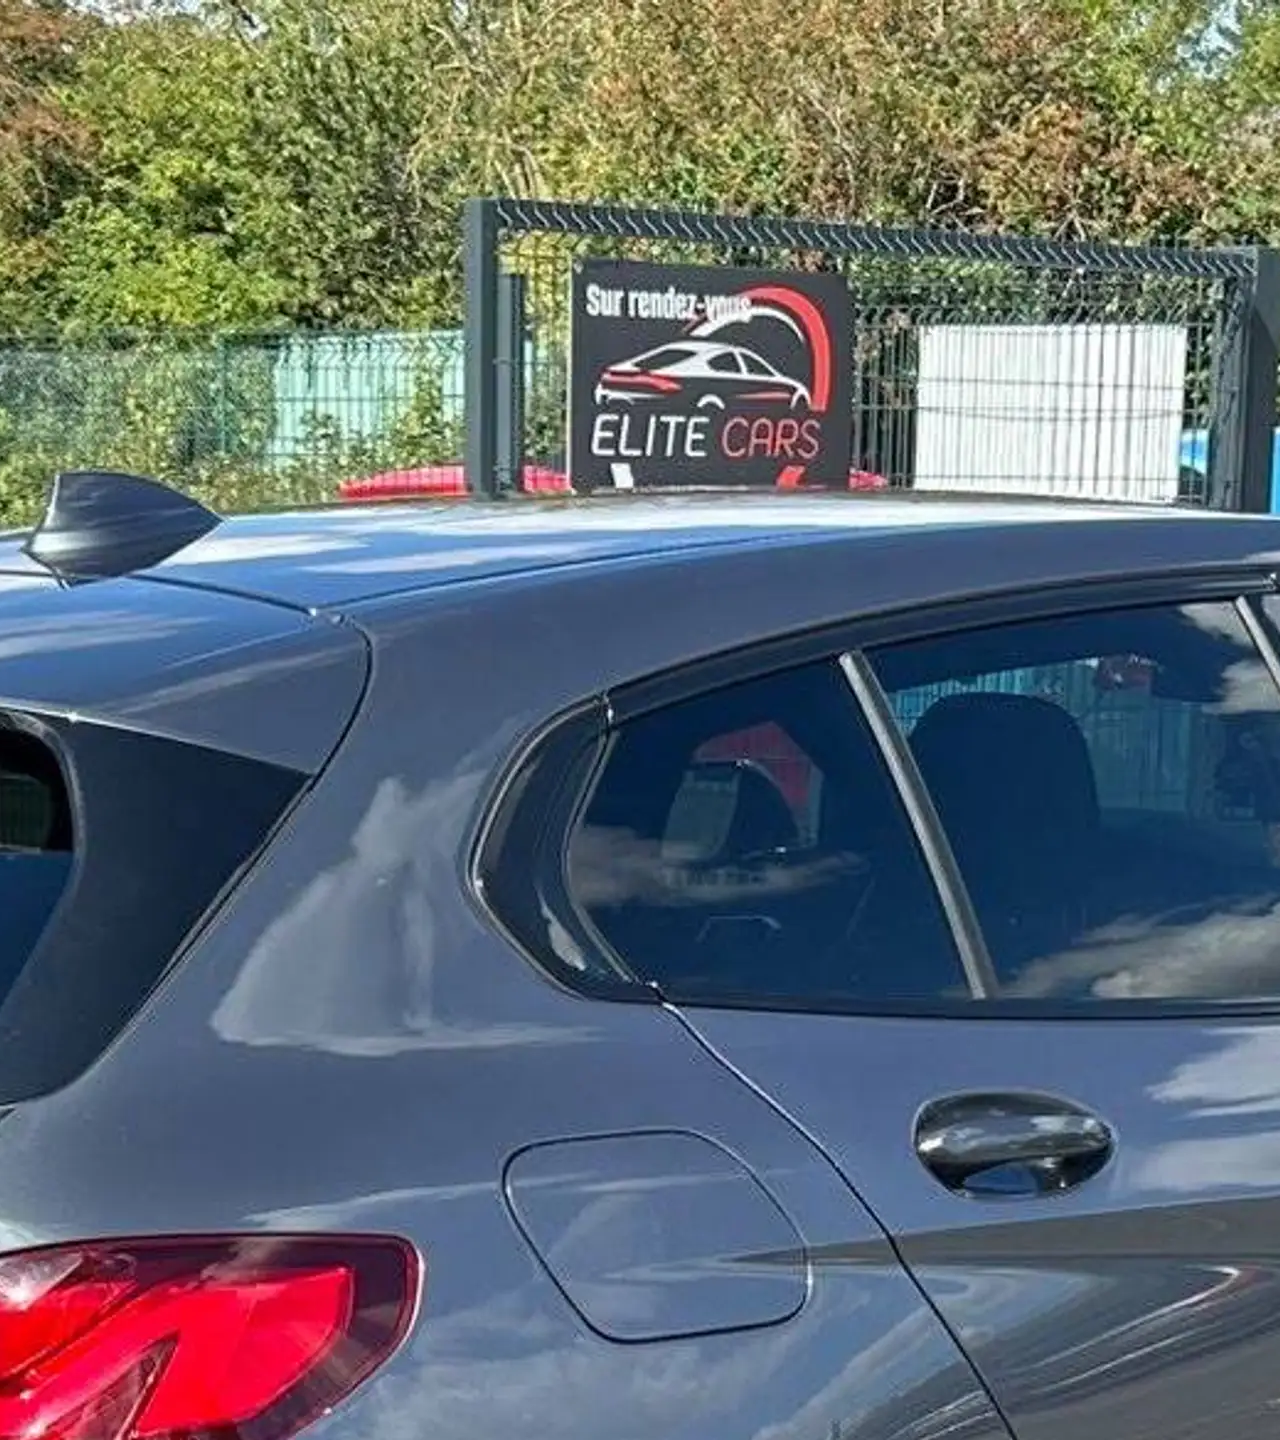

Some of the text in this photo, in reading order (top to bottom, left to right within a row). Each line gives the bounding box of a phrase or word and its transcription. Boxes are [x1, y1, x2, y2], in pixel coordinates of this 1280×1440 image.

[586, 282, 623, 316] Sur
[591, 414, 821, 457] ELITE CARS
